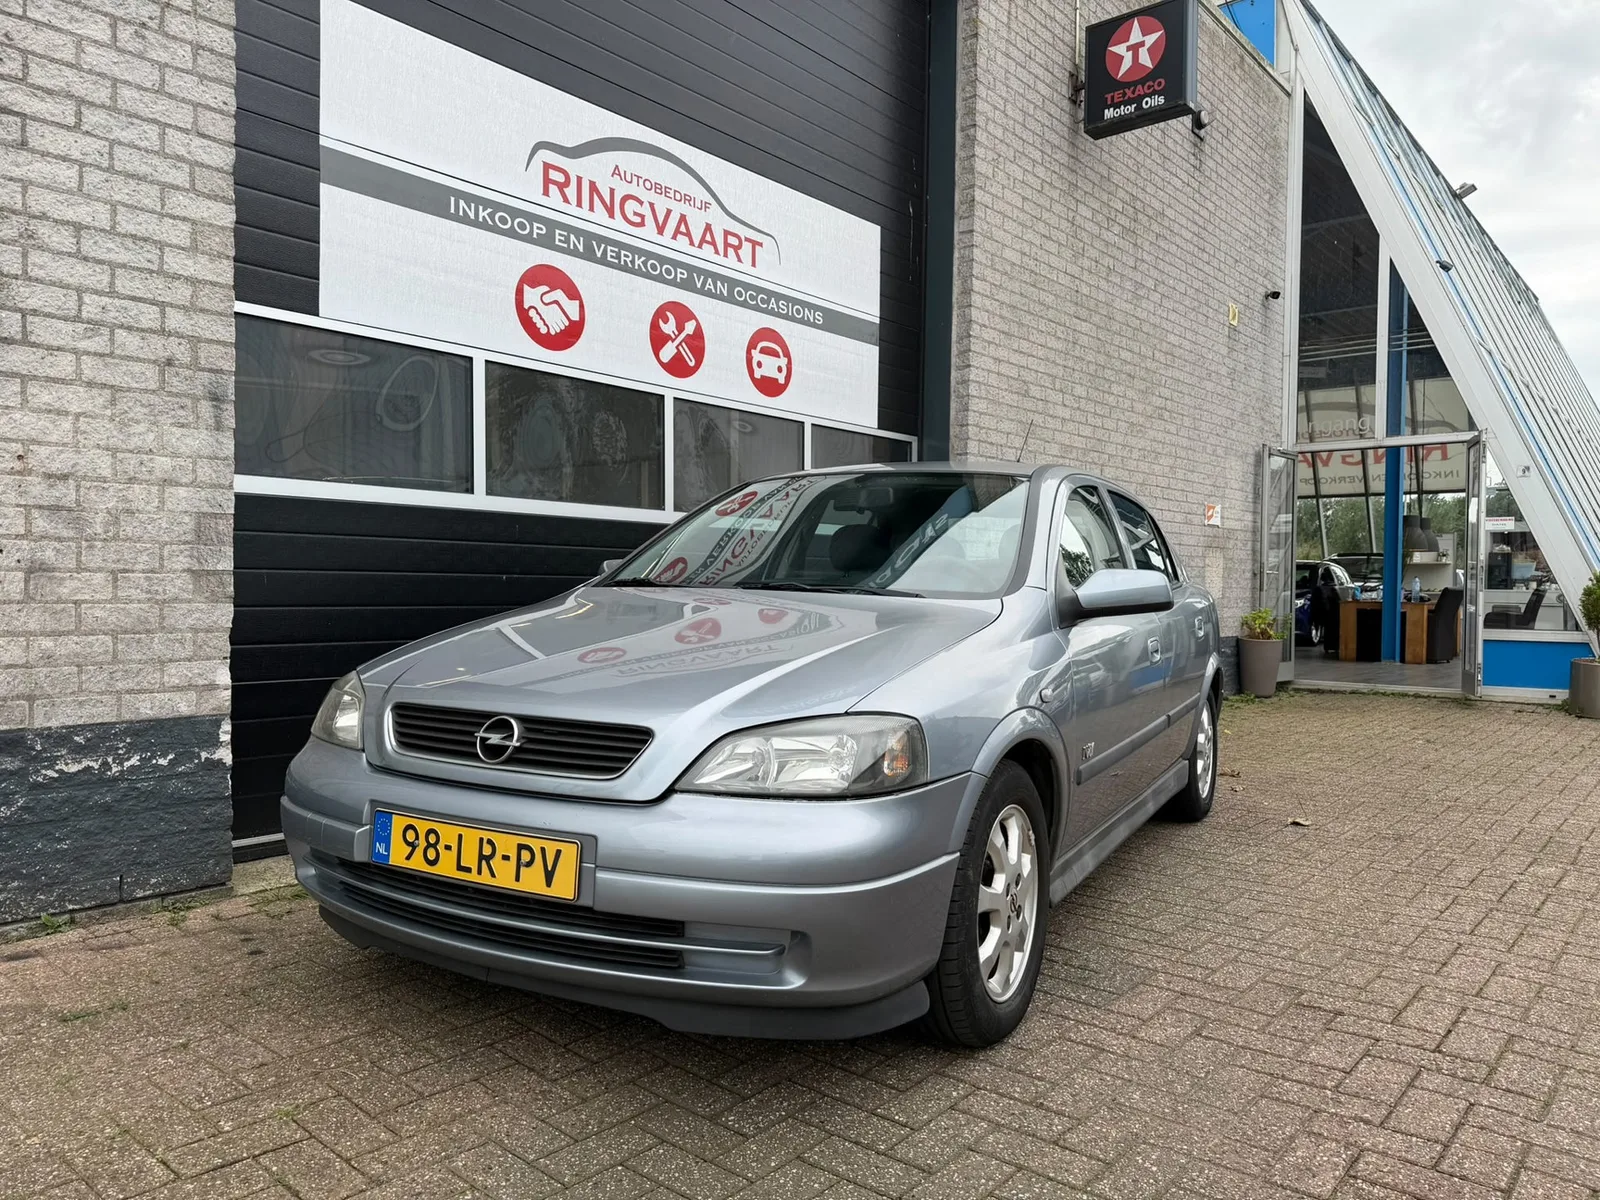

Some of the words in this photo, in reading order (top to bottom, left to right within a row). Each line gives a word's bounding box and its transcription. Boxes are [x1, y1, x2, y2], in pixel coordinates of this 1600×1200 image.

[1103, 102, 1137, 120] Motor
[1142, 94, 1165, 109] Oils
[1104, 78, 1166, 105] TEXACO
[611, 164, 712, 213] AUTOBEDRIJF
[541, 160, 763, 268] RINGVAART
[450, 195, 547, 239] INKOOP
[554, 229, 584, 253] EN
[592, 240, 688, 283] VERKOOP
[693, 272, 728, 297] VAN
[734, 287, 823, 325] OCCASIONS
[375, 842, 388, 855] NL
[401, 823, 562, 888] 98-LR-PV
